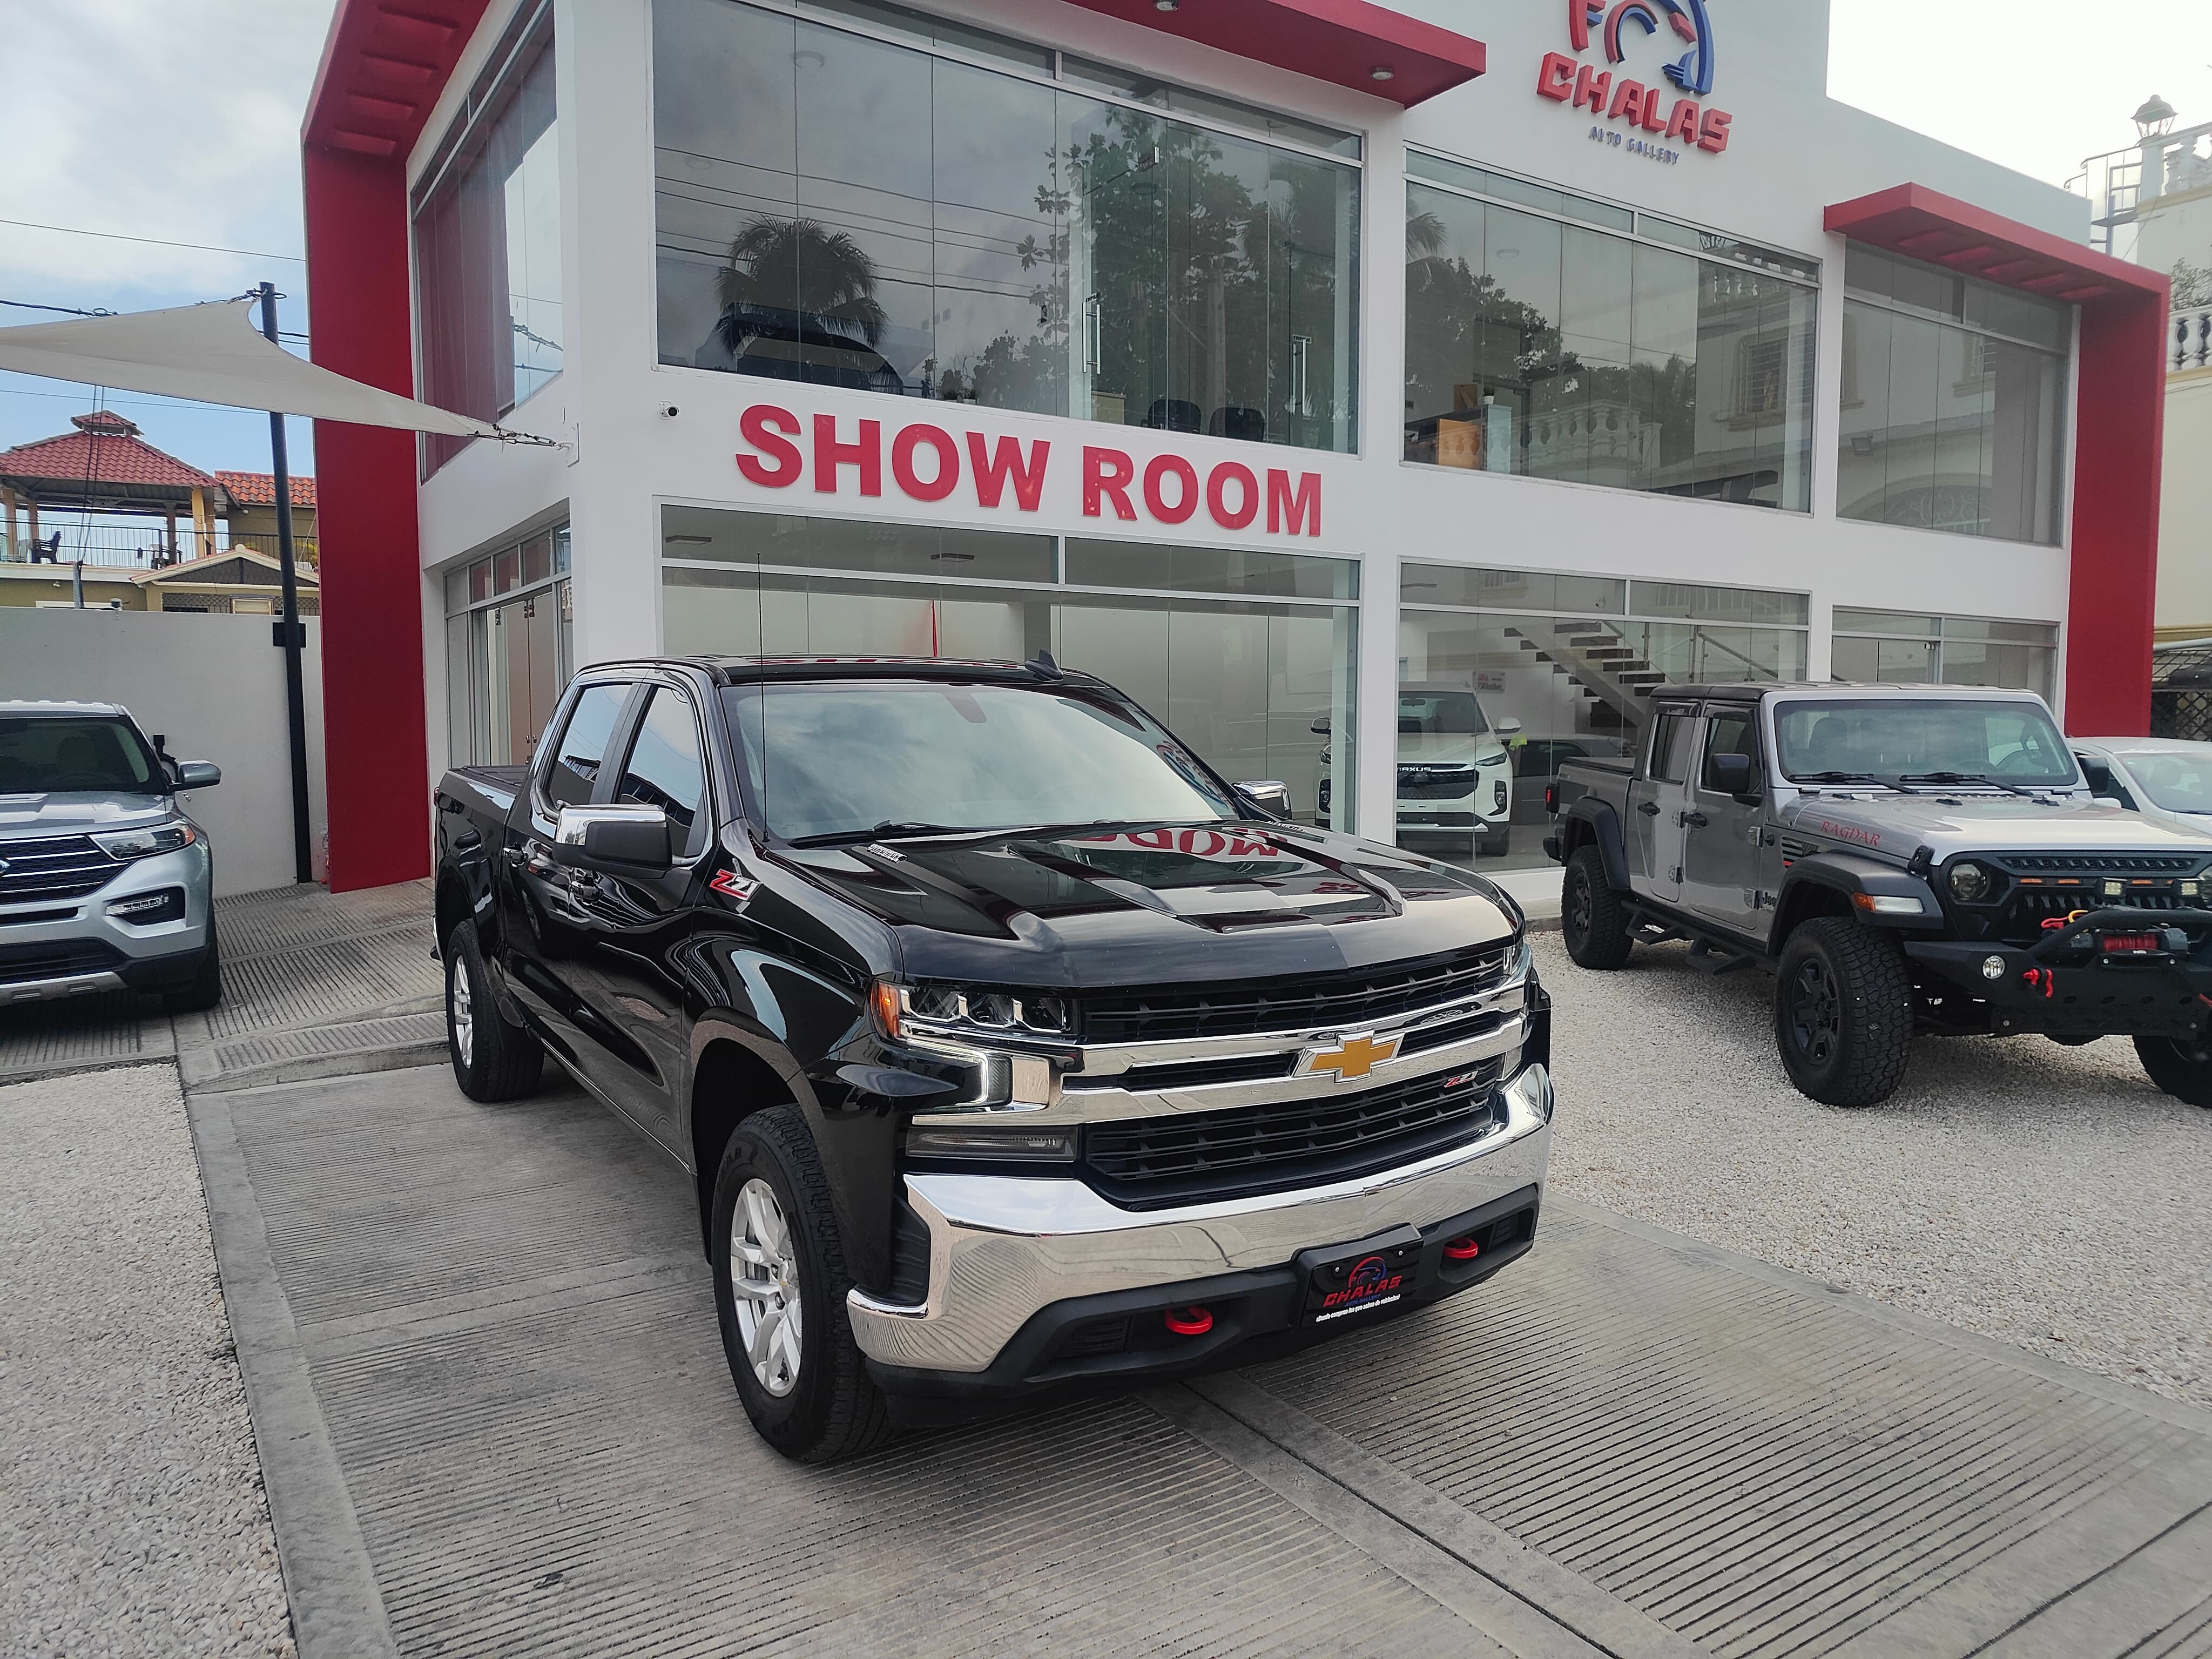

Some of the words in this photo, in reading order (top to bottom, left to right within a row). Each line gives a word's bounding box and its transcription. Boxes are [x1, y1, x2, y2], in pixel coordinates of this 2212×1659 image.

[1537, 52, 1732, 153] CHALAS
[1589, 126, 1621, 147] AUTO
[1627, 138, 1680, 165] GALLERY
[735, 404, 1051, 512] SHOW
[1082, 445, 1322, 537] ROOM
[710, 868, 764, 901] Z71
[1762, 892, 1777, 907] Jee
[1323, 1274, 1403, 1307] CHALAS
